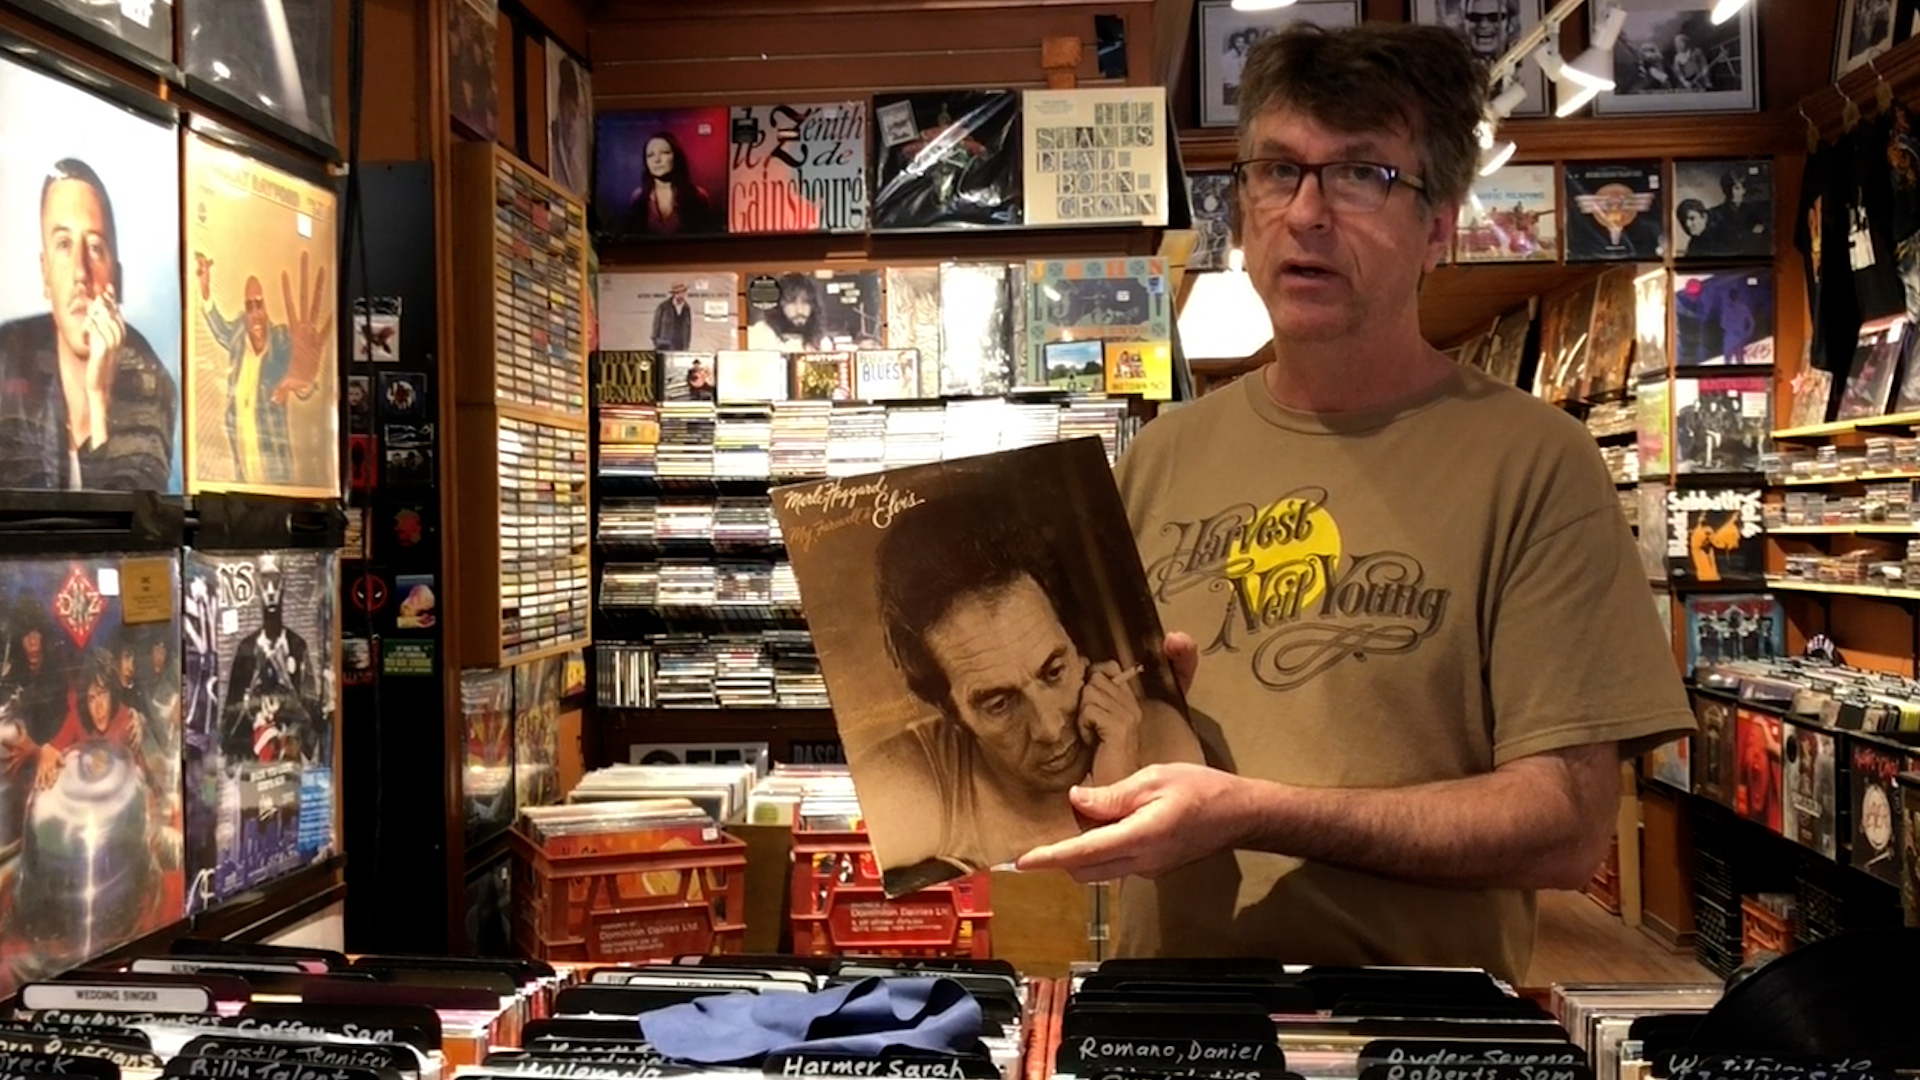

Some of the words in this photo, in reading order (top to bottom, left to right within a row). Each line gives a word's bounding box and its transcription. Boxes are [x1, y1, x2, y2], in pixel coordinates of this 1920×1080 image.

[812, 141, 854, 167] de
[1056, 195, 1157, 218] GROWN
[862, 362, 901, 383] BLUES
[872, 488, 926, 529] Elvis
[1667, 489, 1741, 511] Sabbath
[1205, 558, 1316, 655] Neil
[1317, 551, 1451, 641] Young
[342, 1023, 395, 1043] Sam
[783, 1056, 882, 1078] Harmer
[886, 1059, 965, 1079] Sarah
